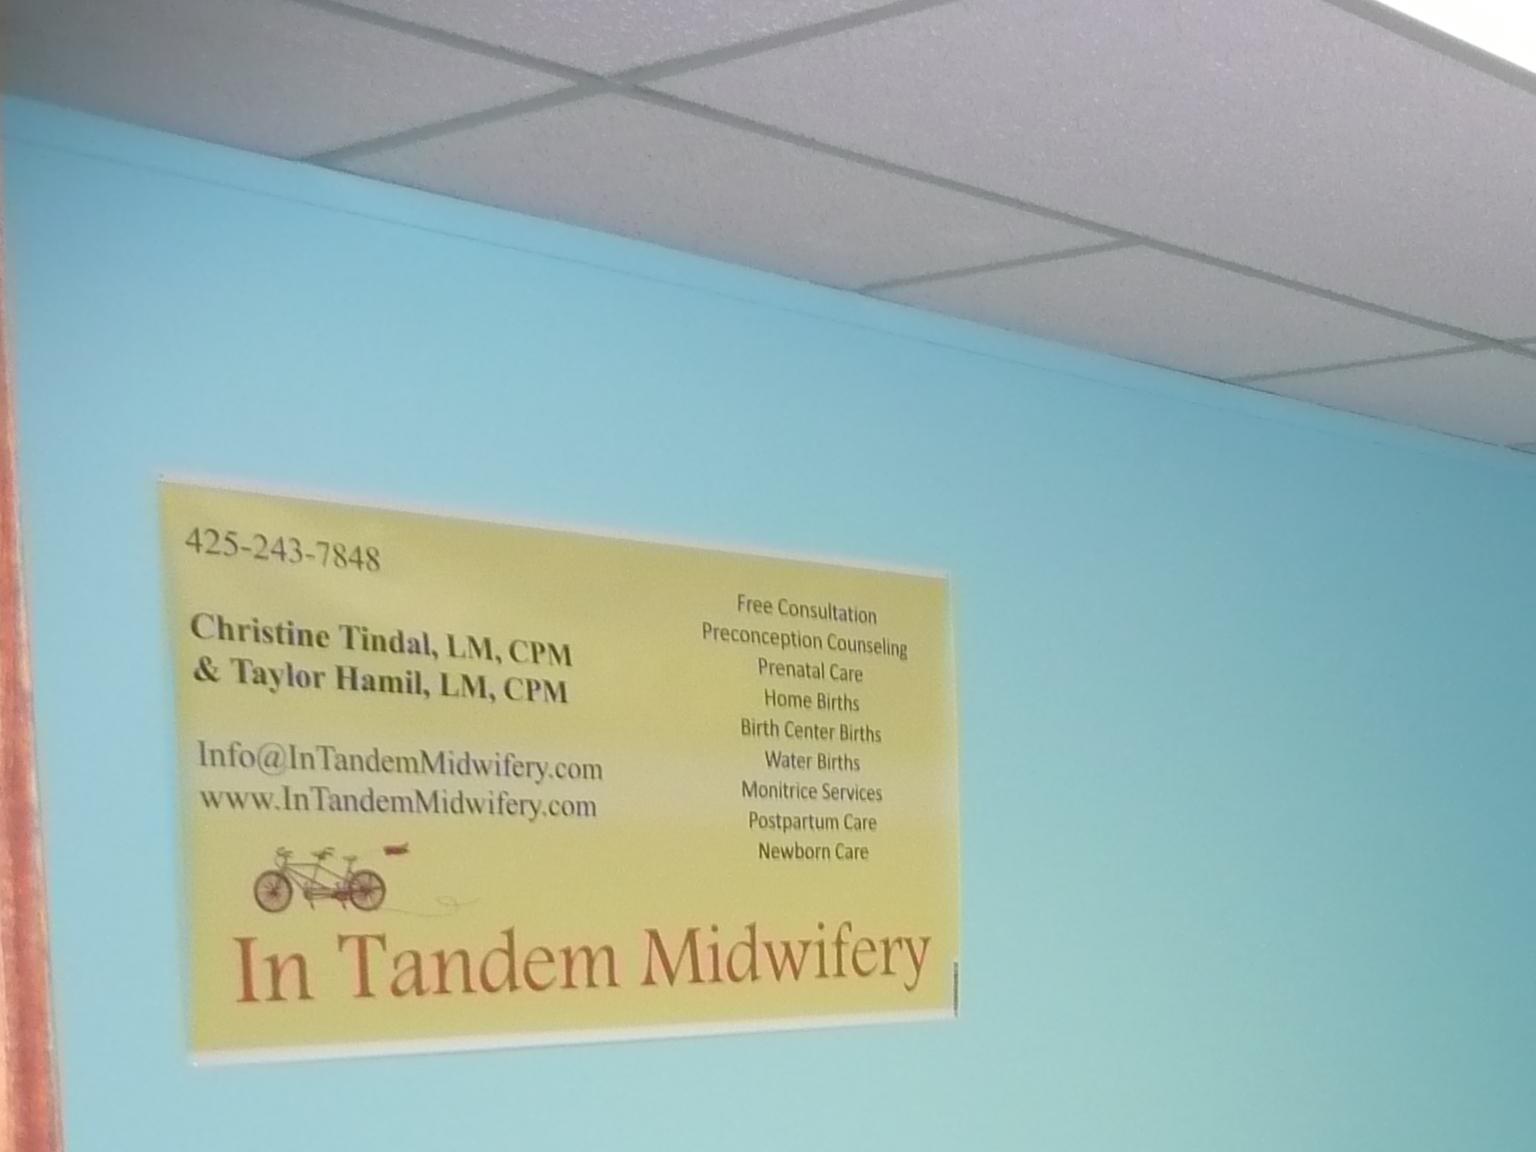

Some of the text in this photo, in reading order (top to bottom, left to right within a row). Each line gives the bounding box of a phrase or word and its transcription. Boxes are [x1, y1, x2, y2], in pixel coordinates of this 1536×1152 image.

[185, 527, 381, 573] 425-243-7848
[737, 593, 878, 625] Free Consultation
[191, 612, 573, 667] Christine Tindal, LM, CPM
[702, 621, 908, 661] Preconception Counseling
[193, 655, 569, 704] & Taylor Hamil, LM, CPM
[758, 657, 864, 683] Prenatal Care
[764, 688, 860, 712] Home Births
[740, 718, 882, 743] Birth Center Births
[197, 740, 603, 784] Info@InTandemMidwifery.com
[764, 751, 861, 772] Water Births
[200, 785, 597, 822] www.InTandemMidwifery.com
[741, 780, 883, 801] Monitrice Services
[749, 810, 877, 834] Postpartum Care
[758, 841, 869, 861] Newborn Care
[233, 935, 315, 1004] In
[337, 926, 620, 998] Tandem
[640, 920, 932, 992] Midwifery
